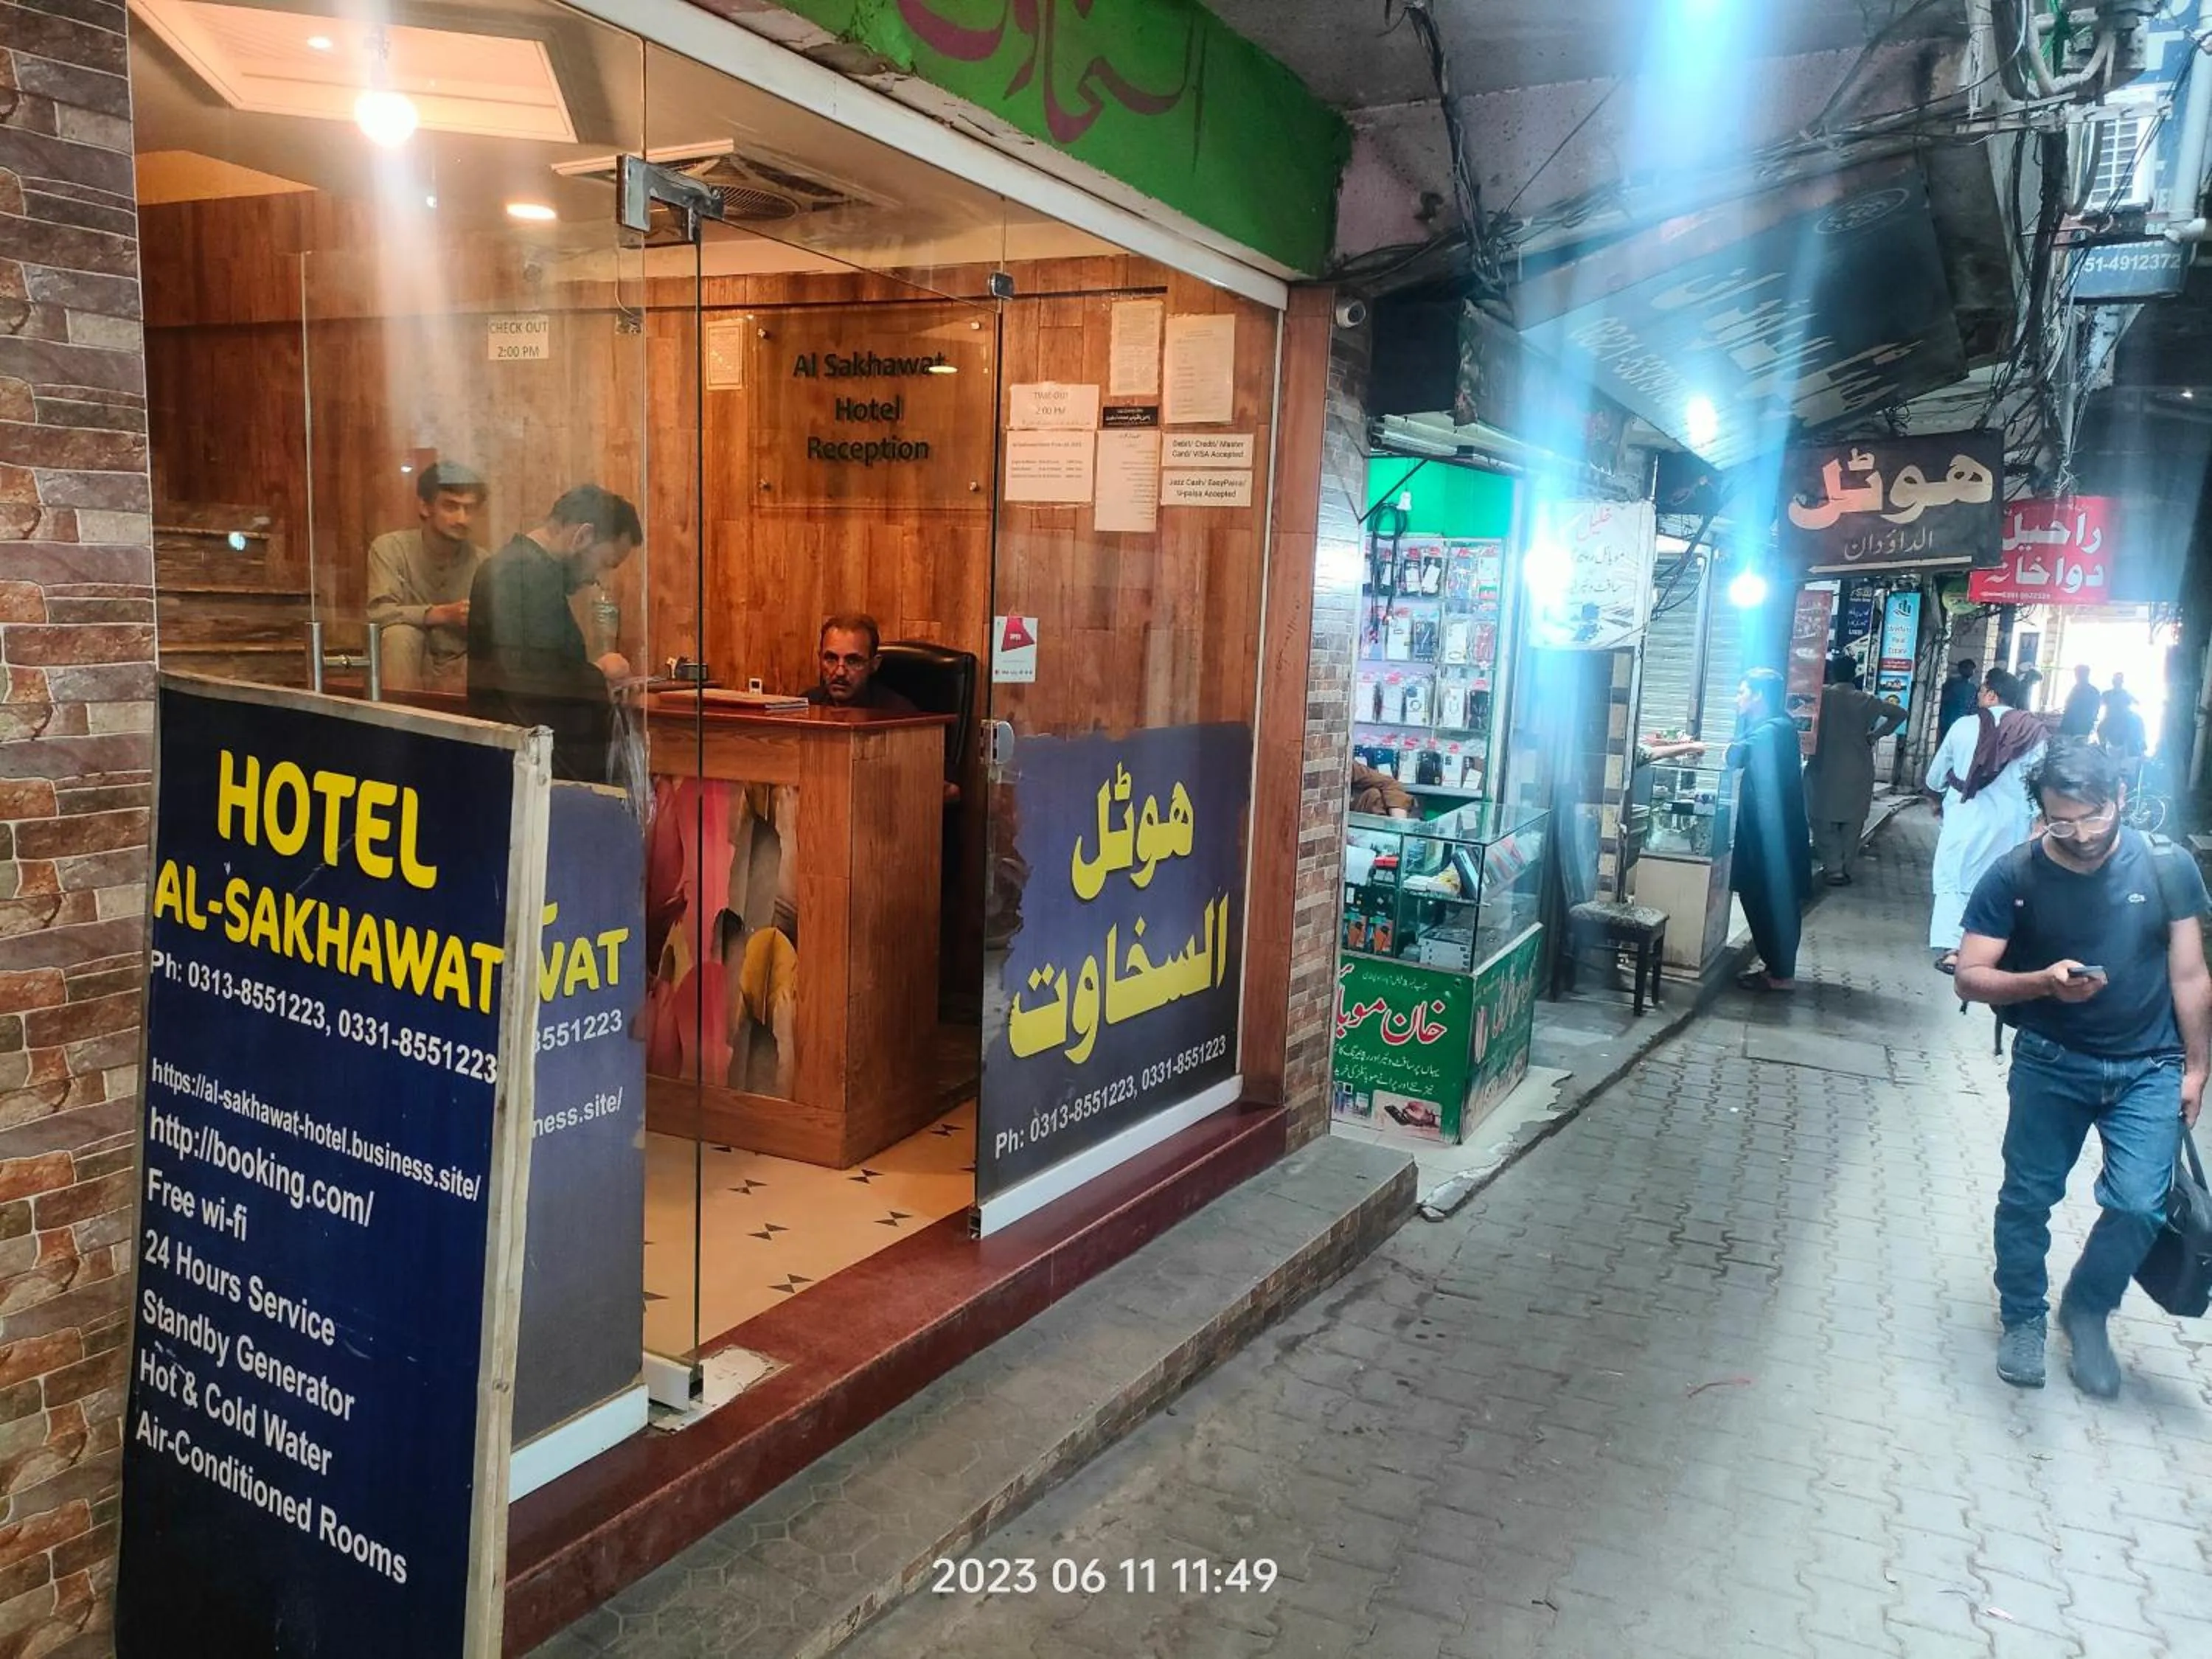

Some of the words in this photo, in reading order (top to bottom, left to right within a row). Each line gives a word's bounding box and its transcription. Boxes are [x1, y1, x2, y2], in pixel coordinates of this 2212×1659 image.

[2082, 253, 2181, 272] 51-4912372
[488, 321, 522, 333] CHECK
[525, 321, 549, 333] OUT
[498, 346, 520, 358] 2:00
[523, 346, 540, 358] PM
[793, 352, 816, 378] Al
[824, 350, 946, 378] Sakhawat
[807, 435, 930, 467] Reception
[835, 394, 902, 422] Hotel
[1211, 450, 1244, 458] Accepted
[1204, 490, 1237, 498] Accepted
[217, 749, 437, 889] HOTEL
[153, 858, 505, 1015] AL-SAKHAWAT
[1009, 890, 1229, 1065] السخاوت
[150, 949, 184, 984] Ph:
[187, 961, 332, 1037] 0313-8551223,
[338, 1008, 498, 1085] 0331-8551223
[1380, 999, 1447, 1046] خان
[151, 1057, 481, 1203] https://al-sakhawat-hotel.business.site/
[994, 1124, 1025, 1160] Ph:
[1029, 1073, 1138, 1144] 0313-8551223,
[1141, 1034, 1227, 1093] 0331-8551223
[147, 1166, 195, 1218] Free
[201, 1197, 248, 1242] wi-fi
[149, 1105, 375, 1228] http://booking.com/
[145, 1228, 170, 1268] 24
[176, 1241, 242, 1303] Hours
[248, 1274, 336, 1347] Service
[139, 1349, 178, 1399] Hot
[182, 1370, 198, 1409] &
[204, 1382, 257, 1439] Cold
[263, 1408, 333, 1477] Water
[142, 1288, 230, 1368] Standby
[236, 1335, 355, 1422] Generator
[135, 1410, 312, 1534] Air-Conditioned
[319, 1504, 408, 1585] Rooms
